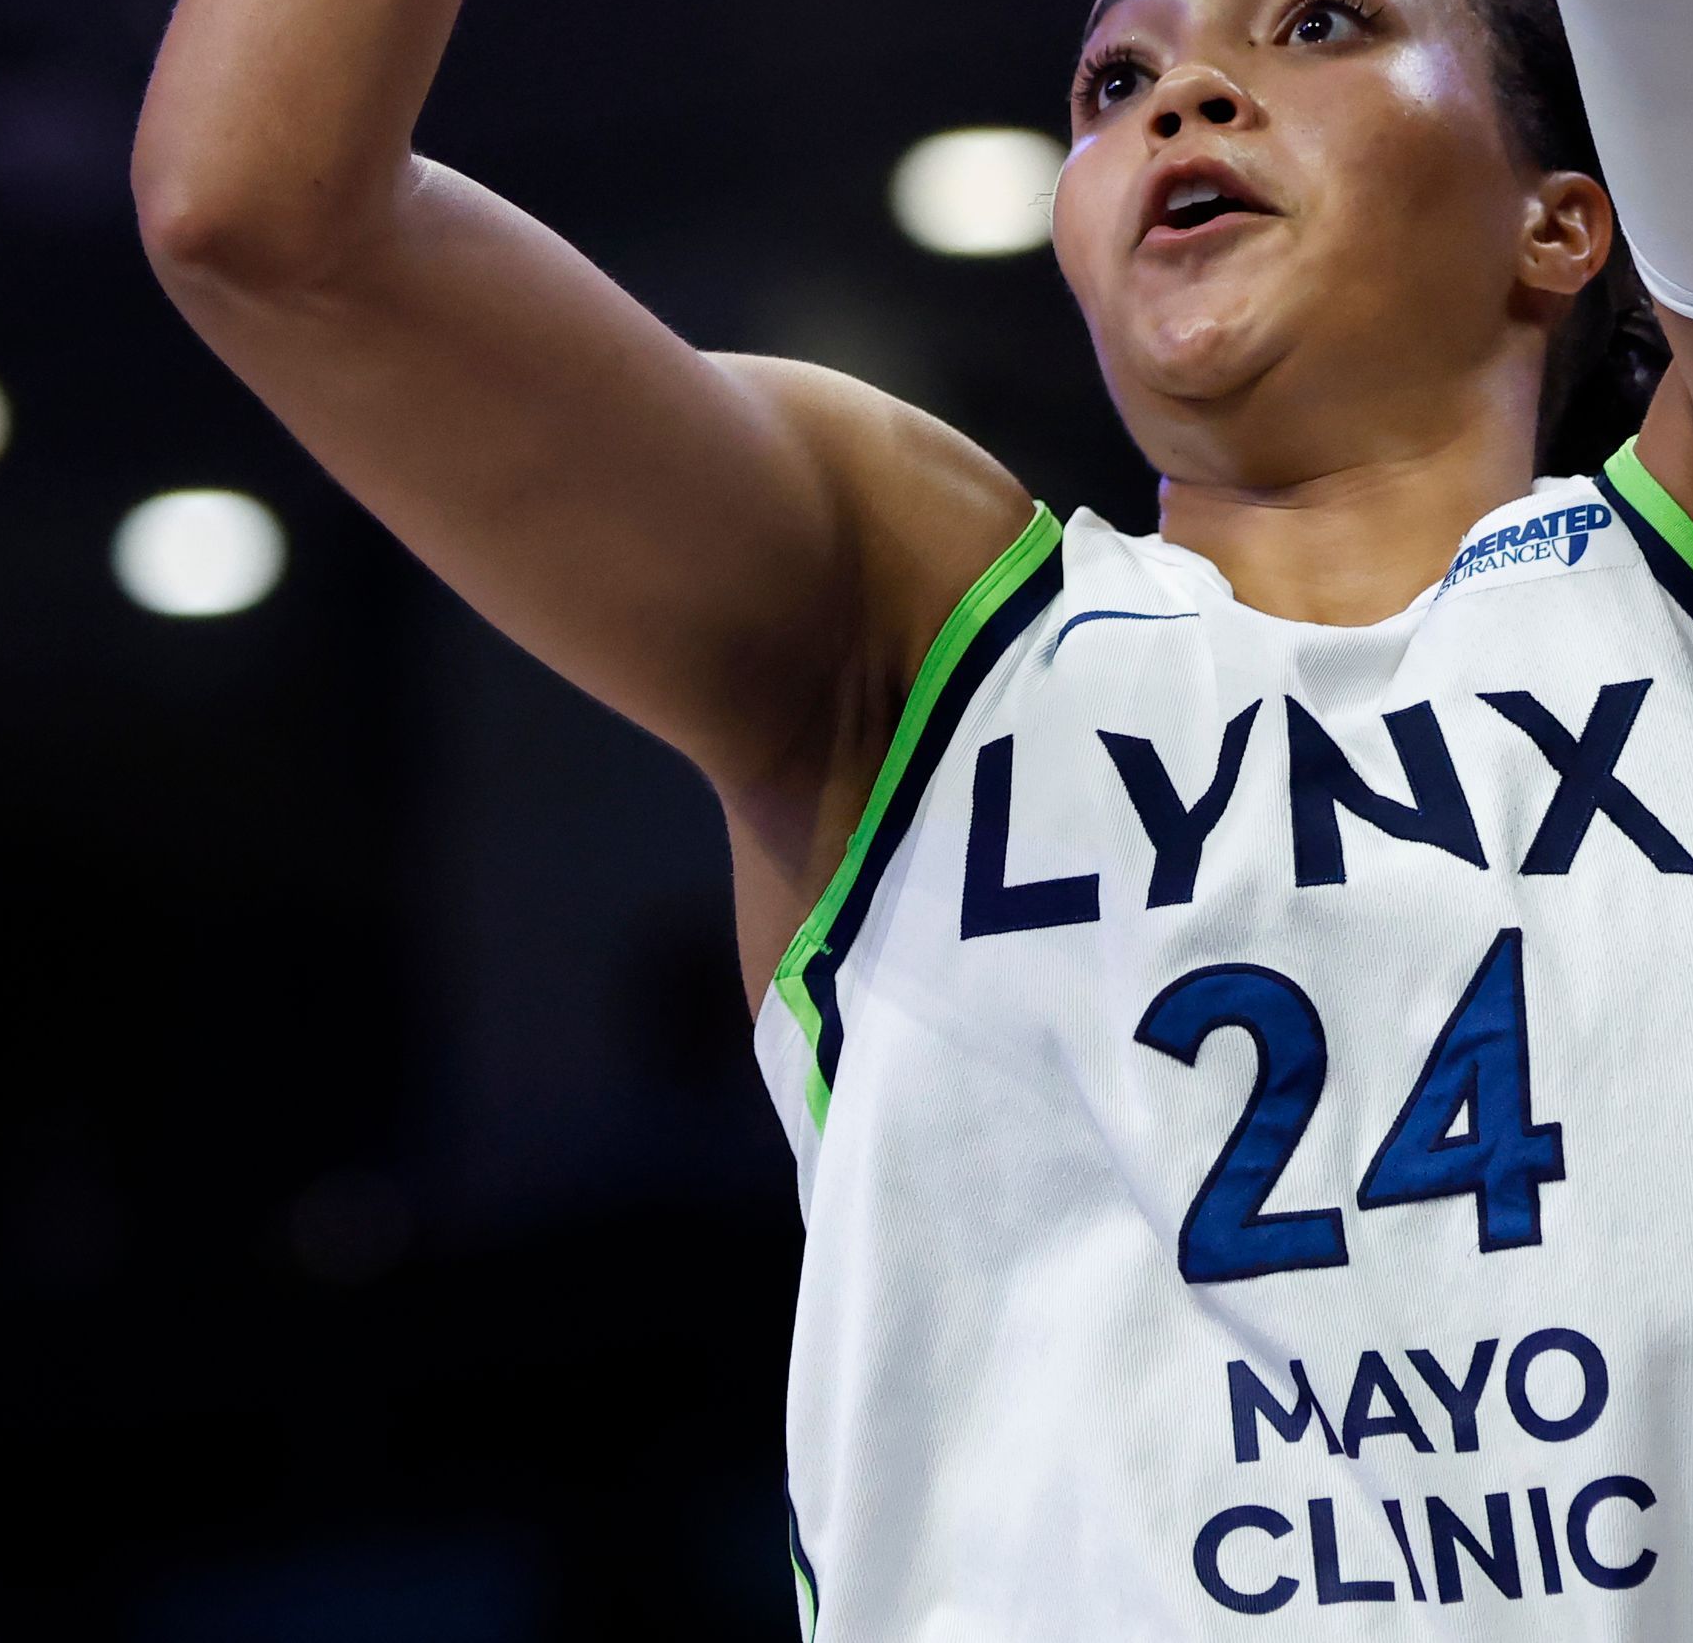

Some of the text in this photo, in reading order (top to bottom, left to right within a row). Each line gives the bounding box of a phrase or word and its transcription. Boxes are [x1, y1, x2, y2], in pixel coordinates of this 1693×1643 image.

[1131, 926, 1568, 1286] 24
[1224, 1326, 1610, 1465] MAYO
[1190, 1473, 1659, 1616] CLINIC
